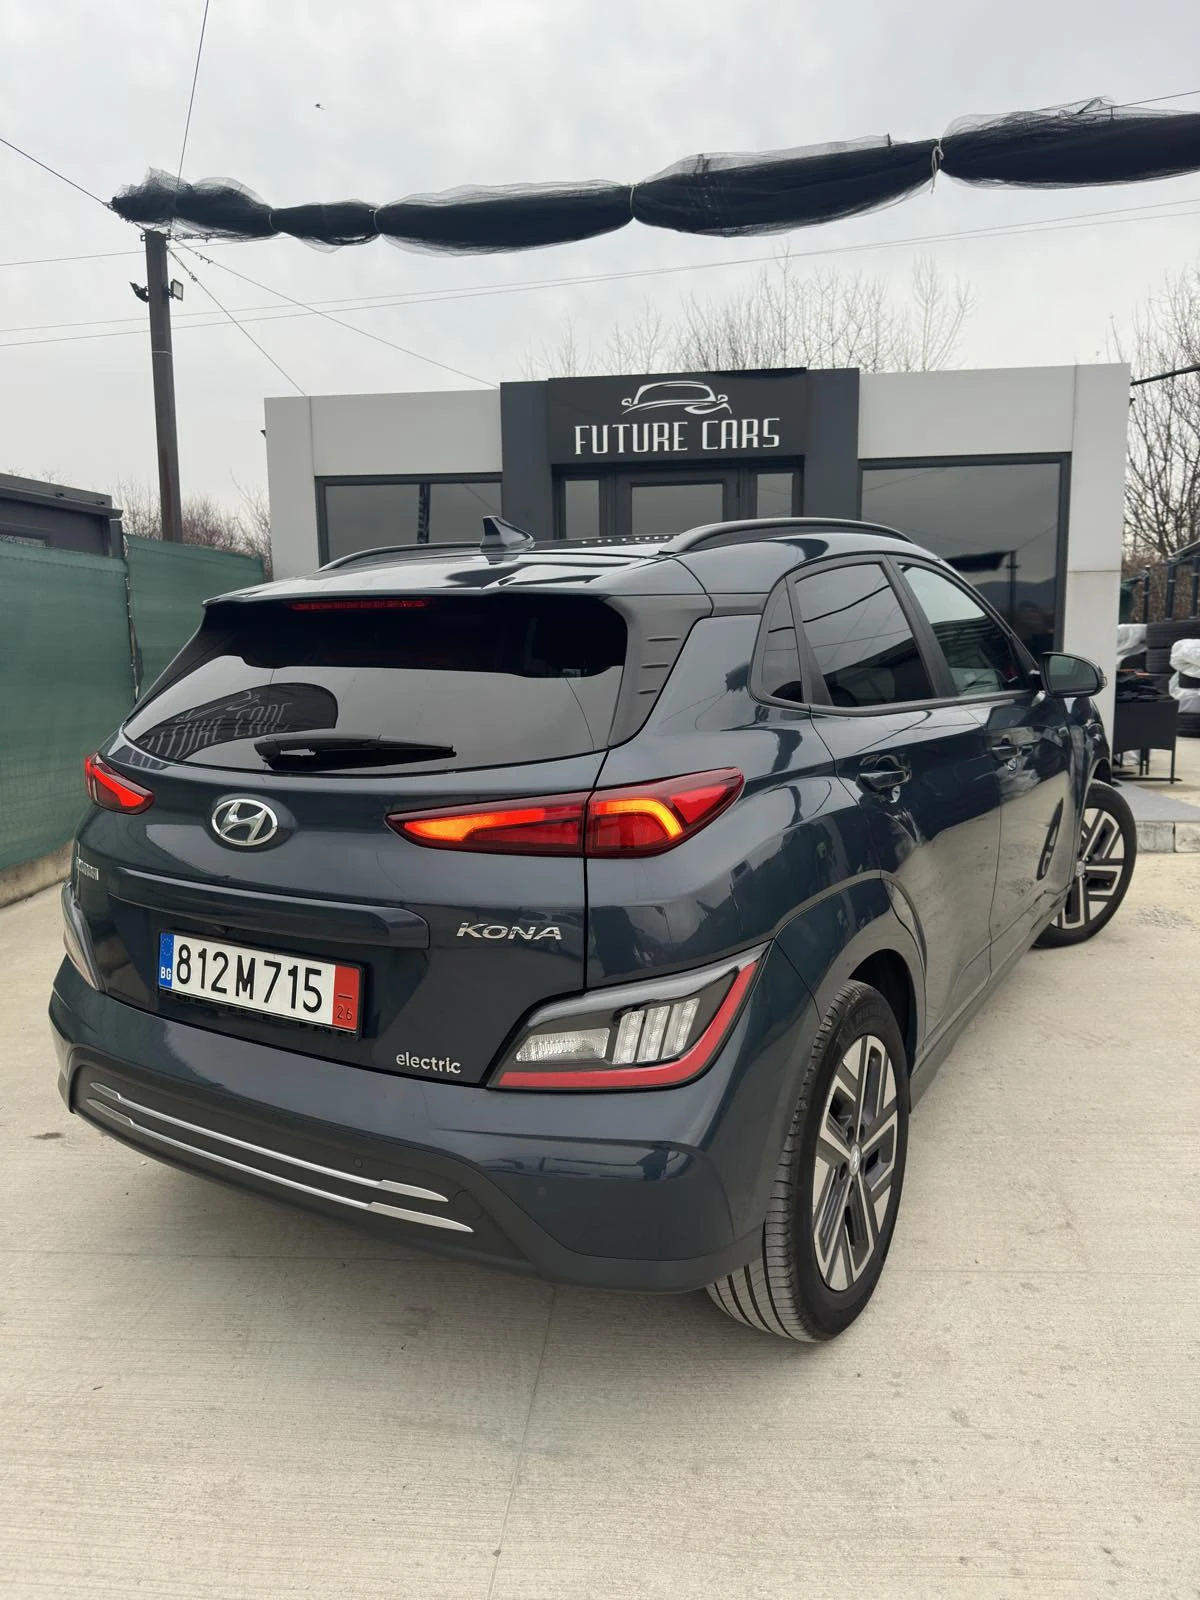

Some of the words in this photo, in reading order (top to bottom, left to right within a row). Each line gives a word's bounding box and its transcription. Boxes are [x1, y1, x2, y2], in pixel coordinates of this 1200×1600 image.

[574, 421, 689, 455] FUTURE
[701, 417, 780, 450] CARS
[456, 922, 562, 940] KONA
[160, 966, 173, 981] BG
[176, 943, 323, 1013] 812M715
[336, 1004, 353, 1021] 26
[395, 1051, 461, 1074] electric
